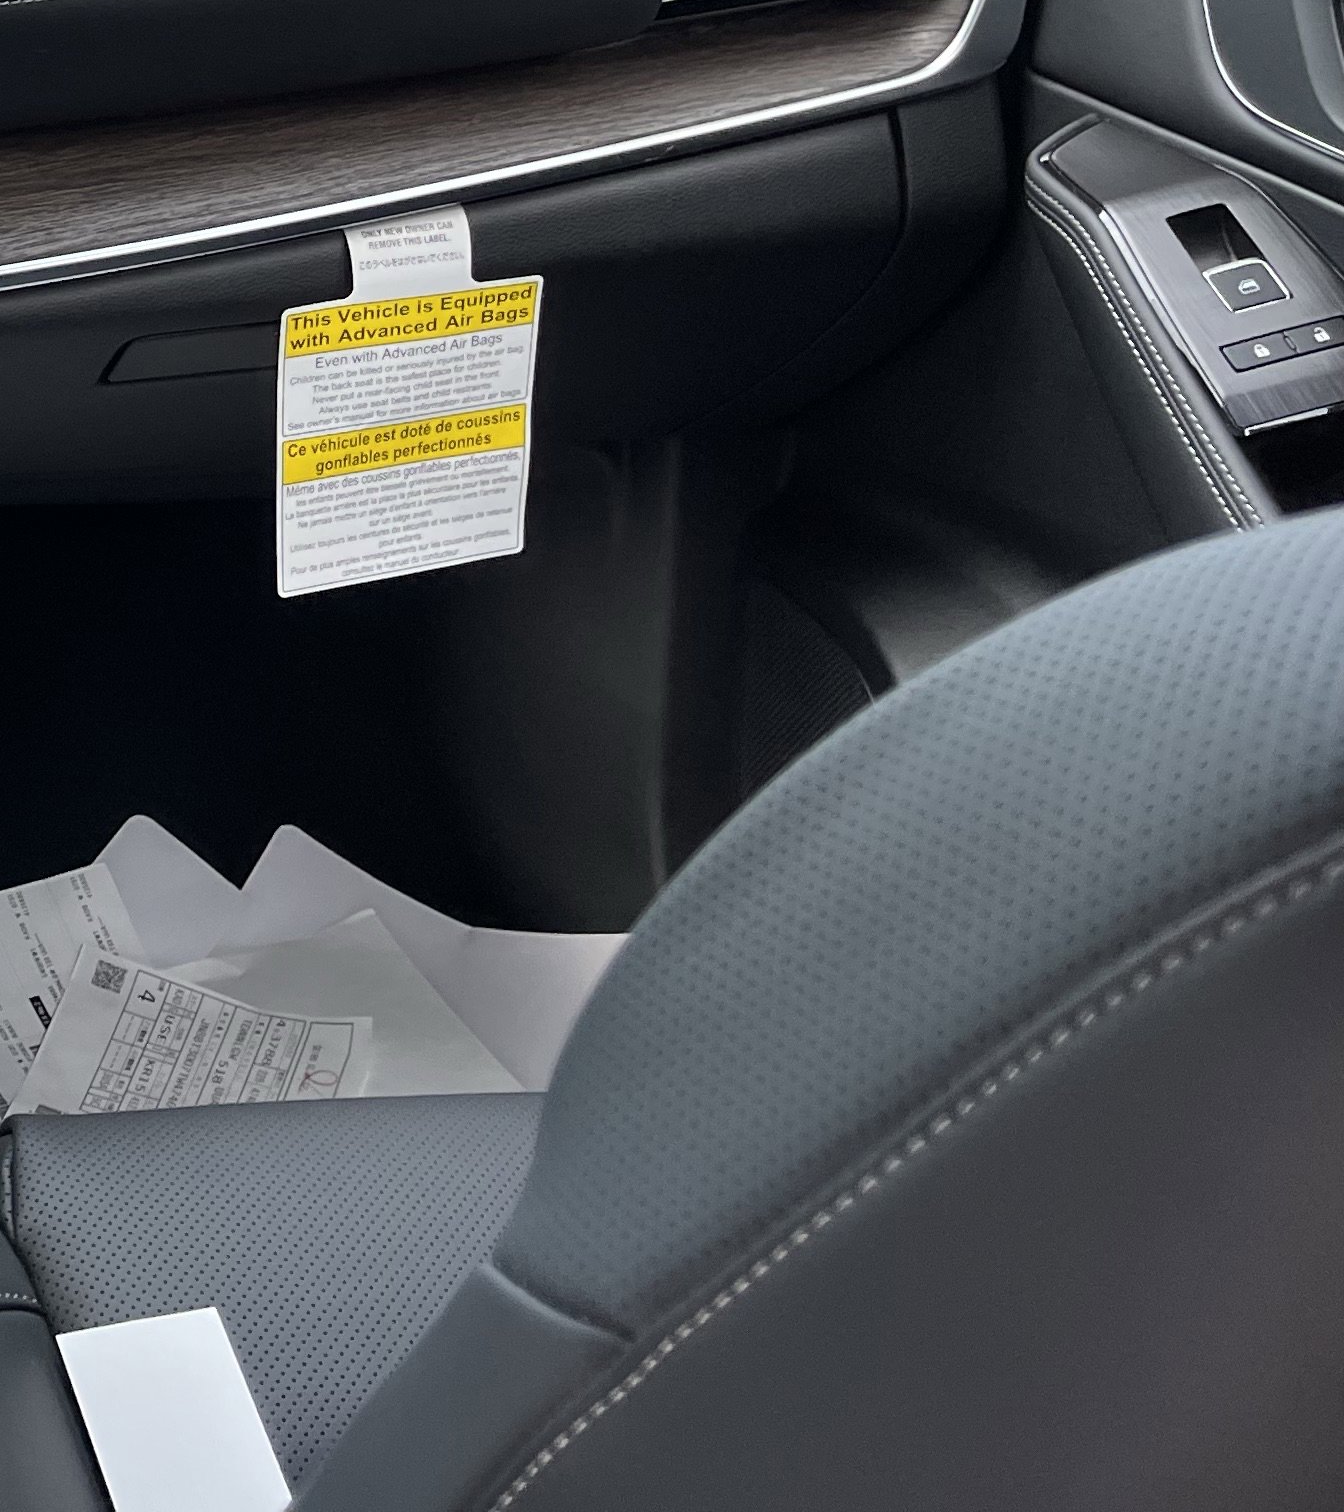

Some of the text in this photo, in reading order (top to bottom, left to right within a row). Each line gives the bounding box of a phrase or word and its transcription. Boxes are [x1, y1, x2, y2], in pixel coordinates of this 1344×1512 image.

[289, 304, 529, 350] with Advanced Air Bags
[290, 284, 532, 330] This Vehicle is Equipped
[314, 331, 503, 368] Even with Advanced Air Bags
[287, 407, 520, 457] Ce véhicule est doté de coussins
[314, 430, 492, 475] gonflables perfectionnés
